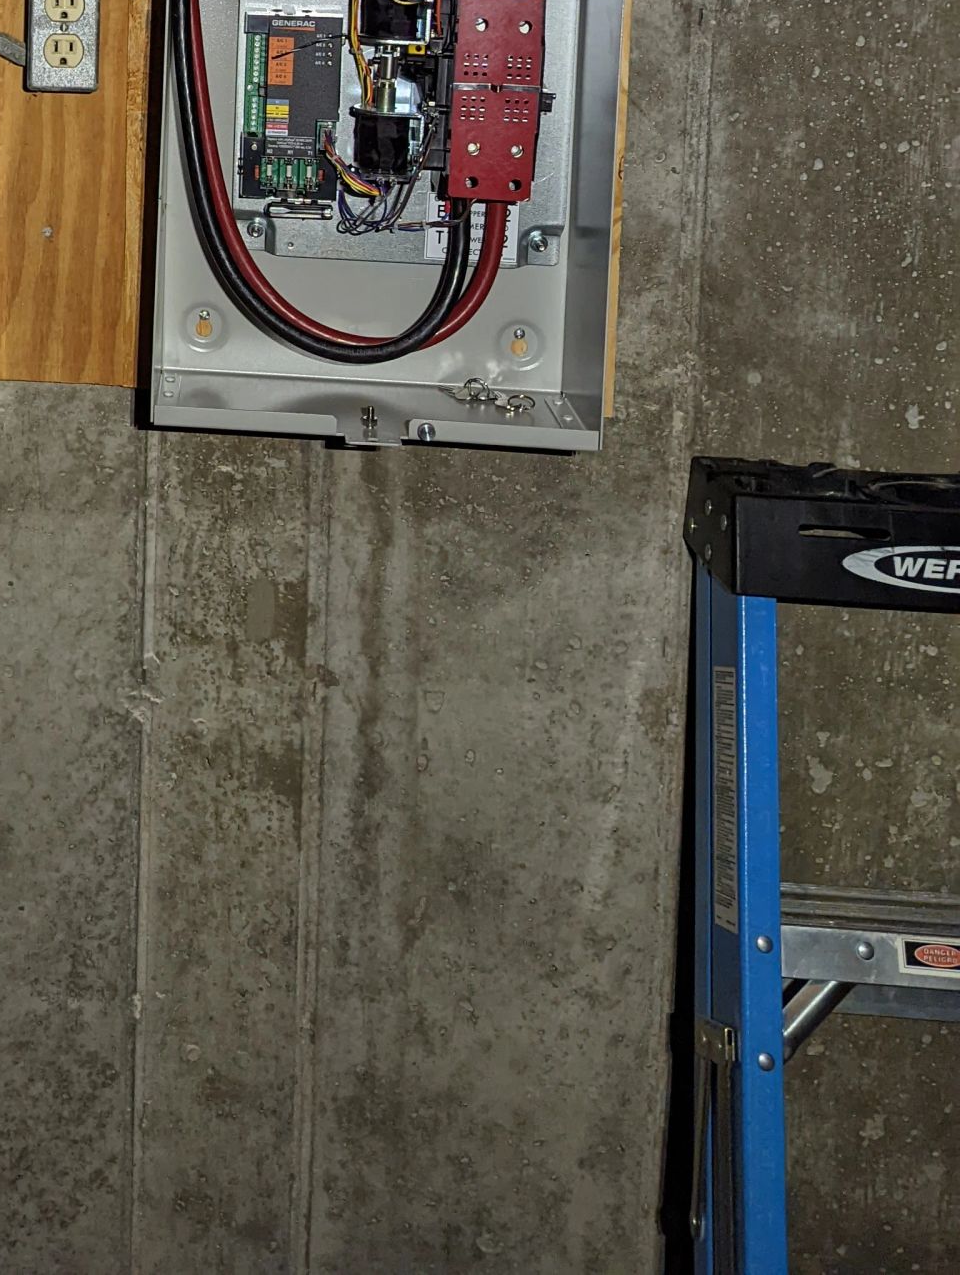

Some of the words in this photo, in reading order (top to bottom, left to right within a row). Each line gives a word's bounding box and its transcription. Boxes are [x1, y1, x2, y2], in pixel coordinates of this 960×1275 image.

[272, 19, 316, 27] GENERAC
[923, 947, 957, 956] DANGER
[923, 955, 958, 964] PELIGRO
